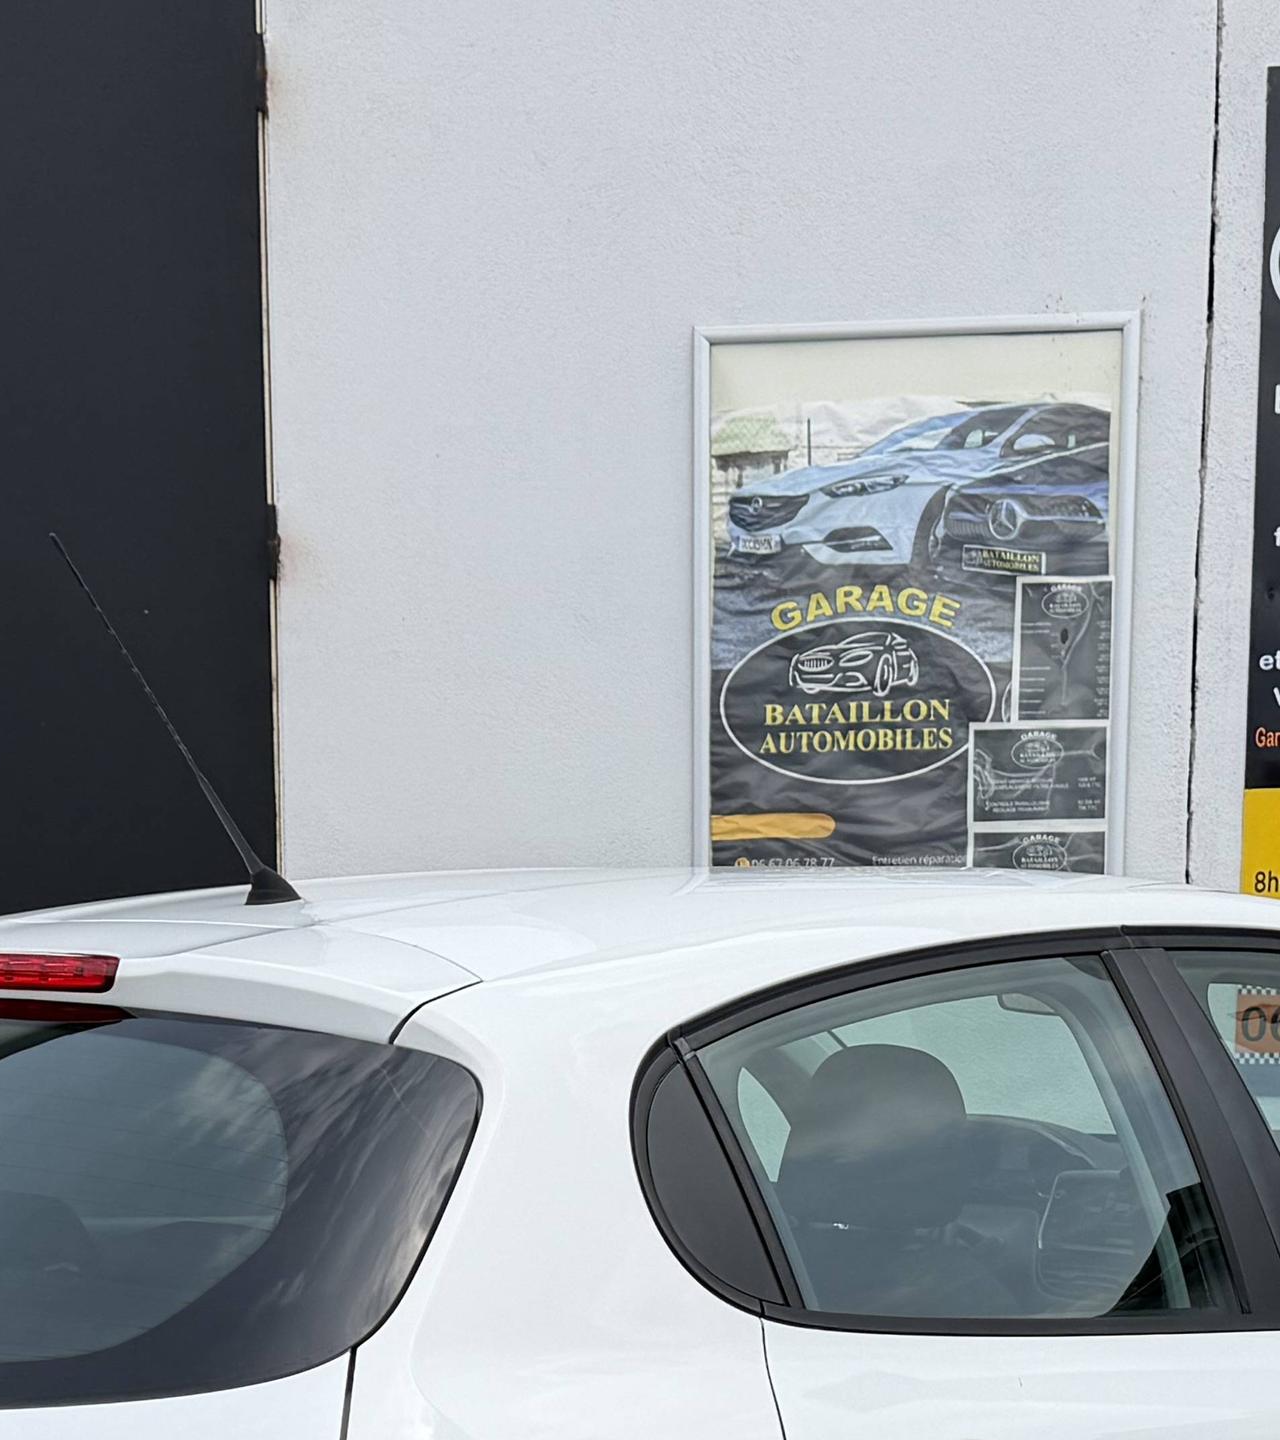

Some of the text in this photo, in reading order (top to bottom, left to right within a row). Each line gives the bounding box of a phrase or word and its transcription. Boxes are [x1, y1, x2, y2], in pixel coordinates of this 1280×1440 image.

[771, 584, 961, 630] GARAGE
[764, 698, 951, 726] BATAILLON
[759, 727, 953, 754] AUTOMOBILES
